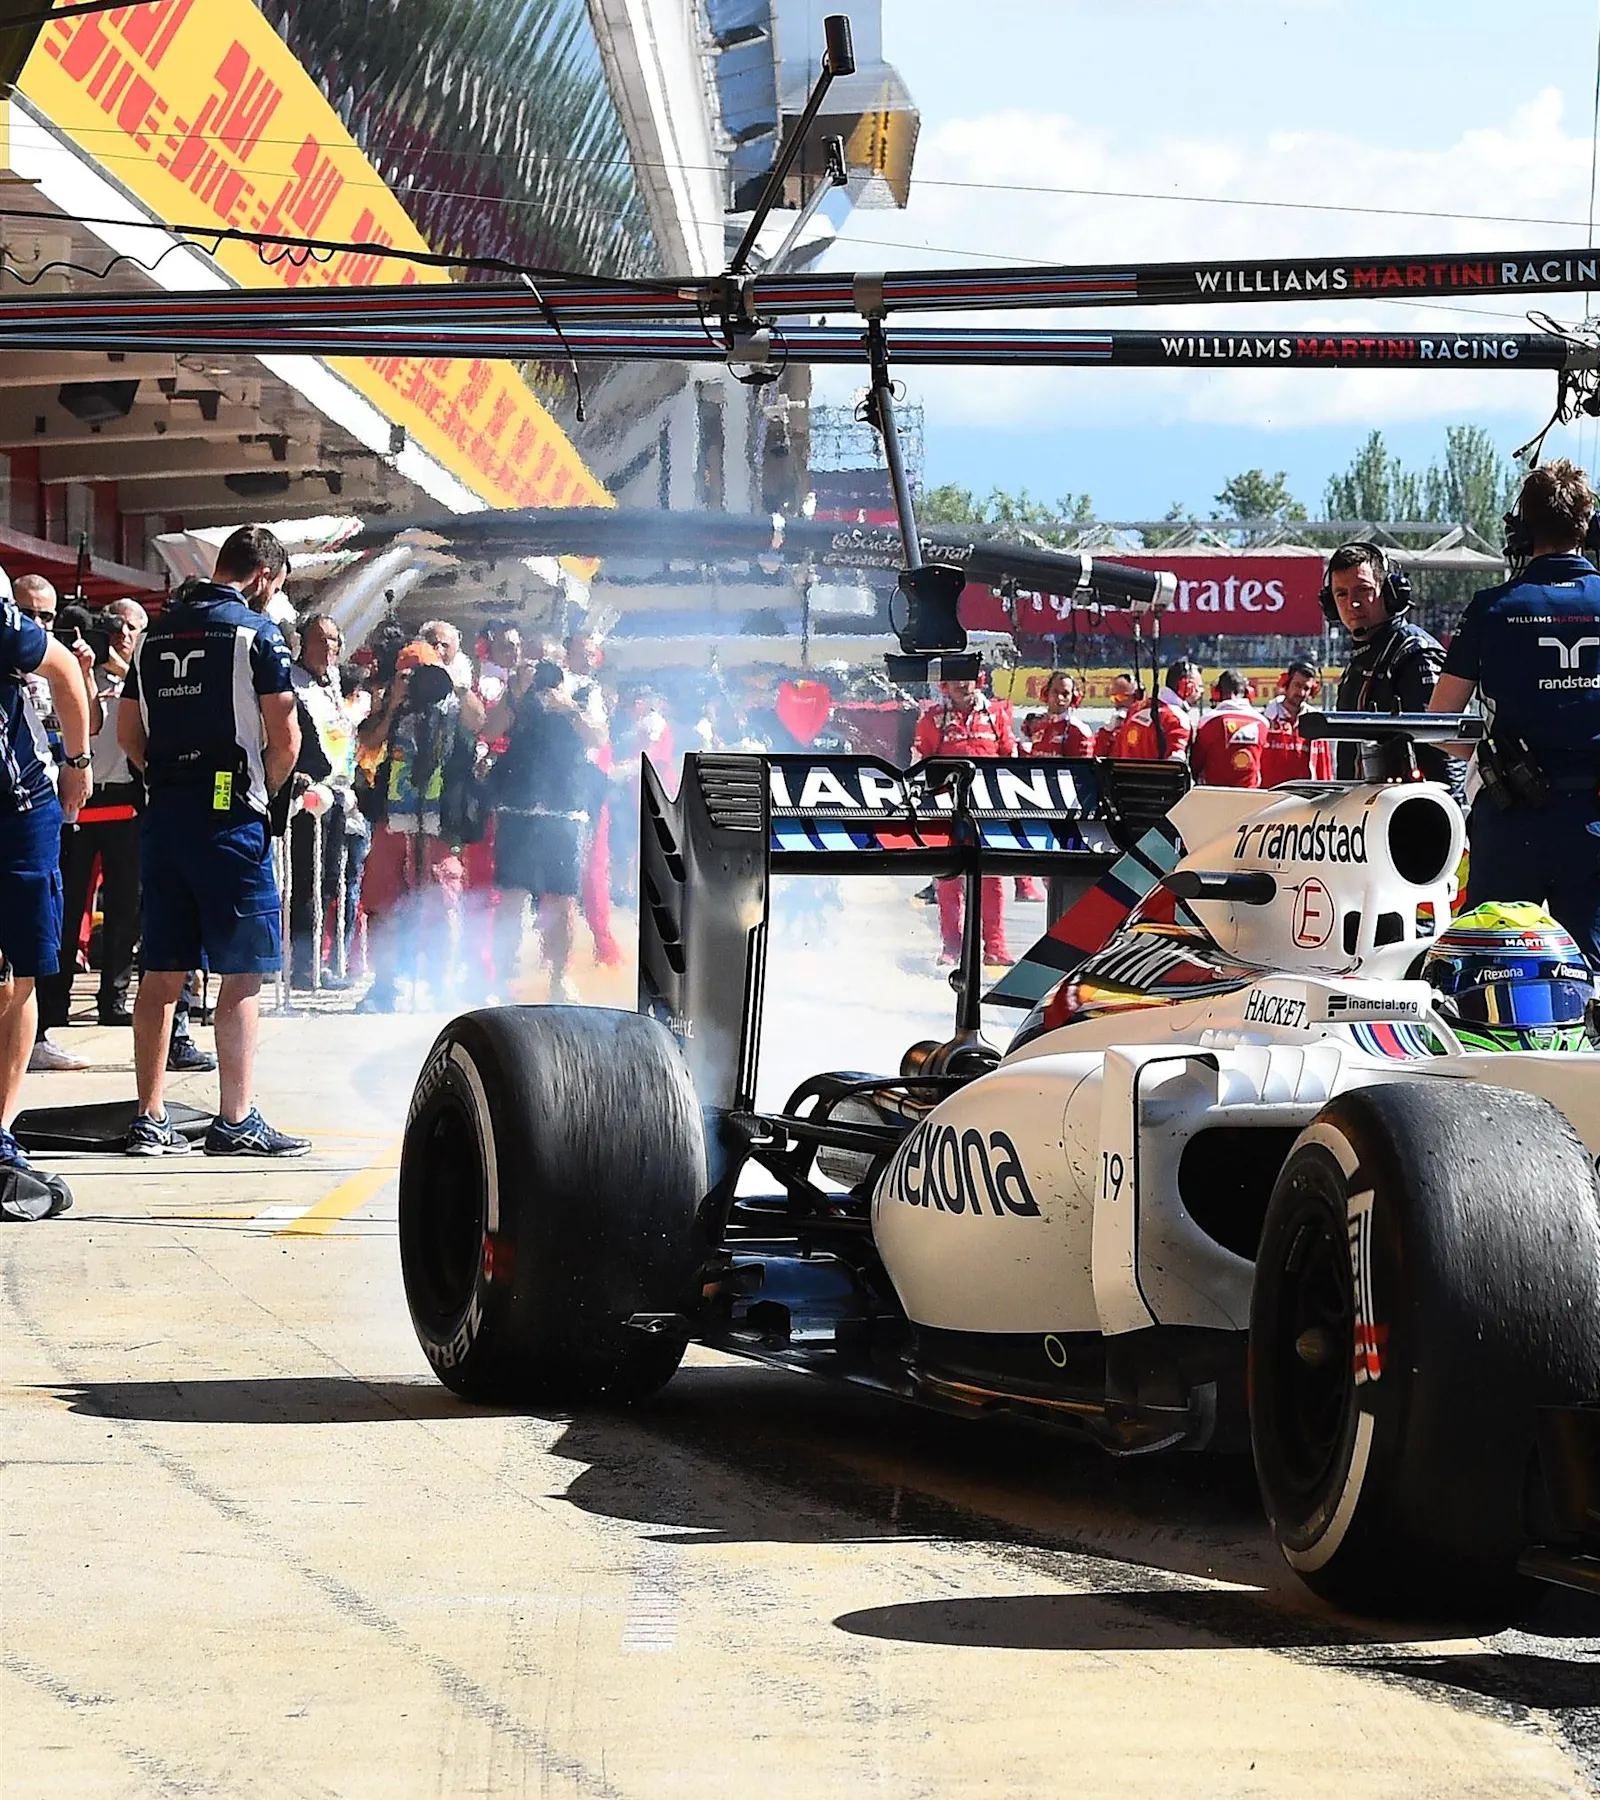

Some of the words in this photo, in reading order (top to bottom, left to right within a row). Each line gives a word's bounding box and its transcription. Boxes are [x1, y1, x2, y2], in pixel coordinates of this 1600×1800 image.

[1195, 268, 1347, 292] WILLIAMS
[1353, 264, 1495, 288] MARTINI
[1161, 337, 1292, 358] WILLIAMS
[1296, 337, 1415, 359] MARTINI
[1419, 339, 1520, 360] RACING
[1507, 616, 1552, 624] WILLIAMS
[158, 682, 202, 698] randstad
[1539, 674, 1600, 690] randstad
[1258, 810, 1369, 864] randstad
[1297, 886, 1322, 943] E
[1484, 966, 1525, 981] Rexona
[1103, 1151, 1125, 1202] 19
